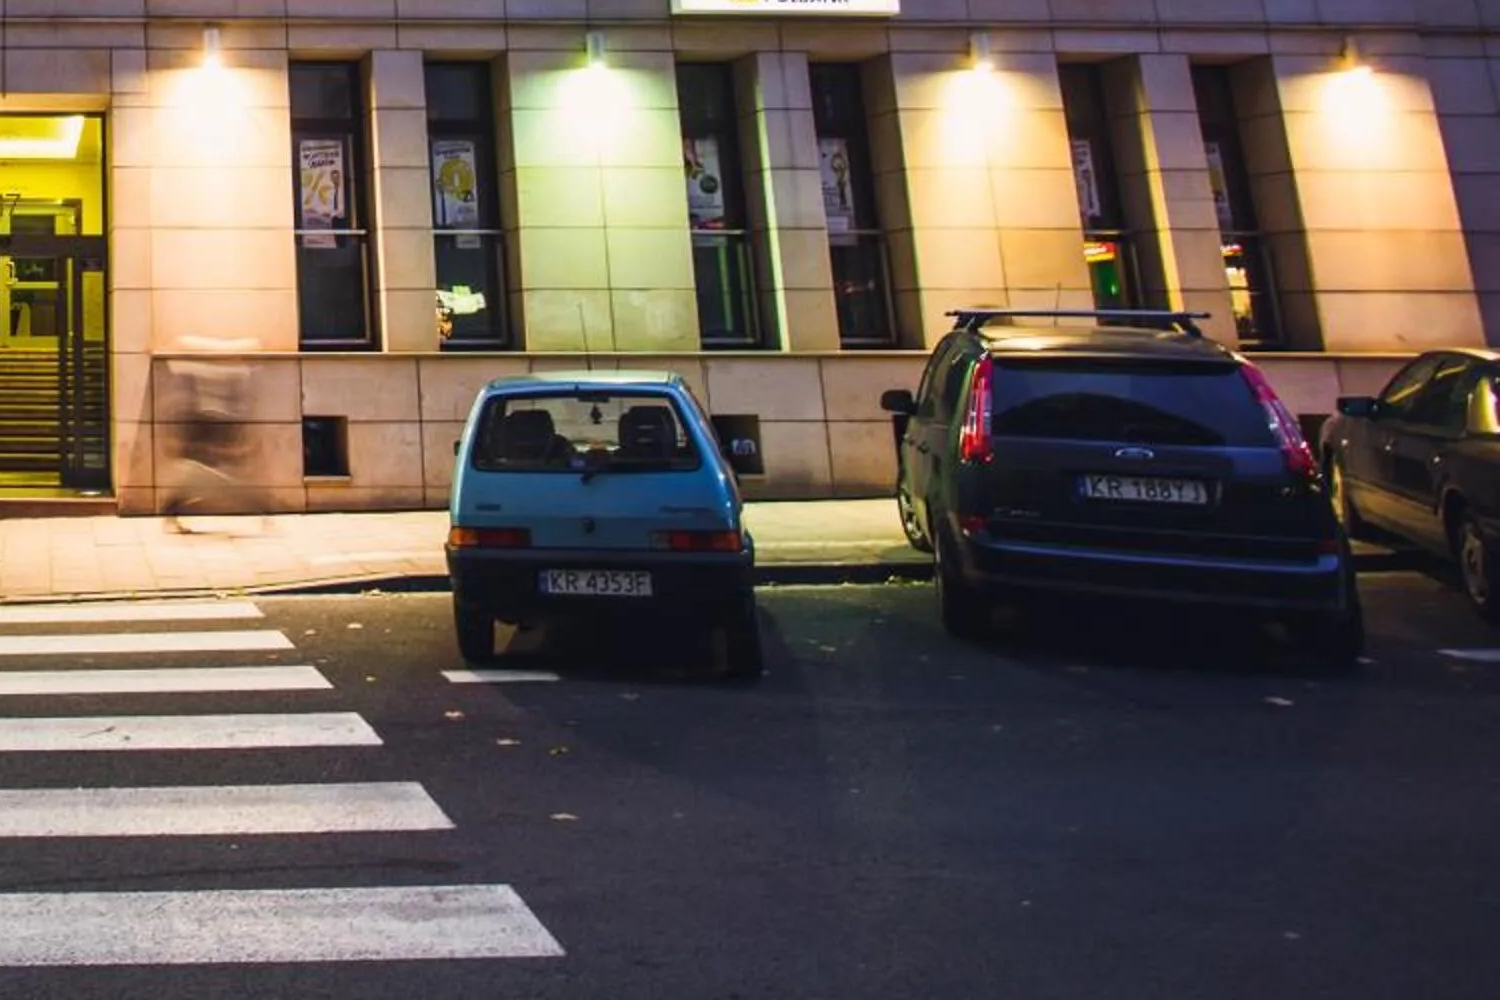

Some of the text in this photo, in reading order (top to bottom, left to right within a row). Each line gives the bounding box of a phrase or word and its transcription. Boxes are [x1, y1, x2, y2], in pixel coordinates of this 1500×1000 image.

[1090, 476, 1123, 498] KR
[550, 571, 648, 594] KR 4353F
